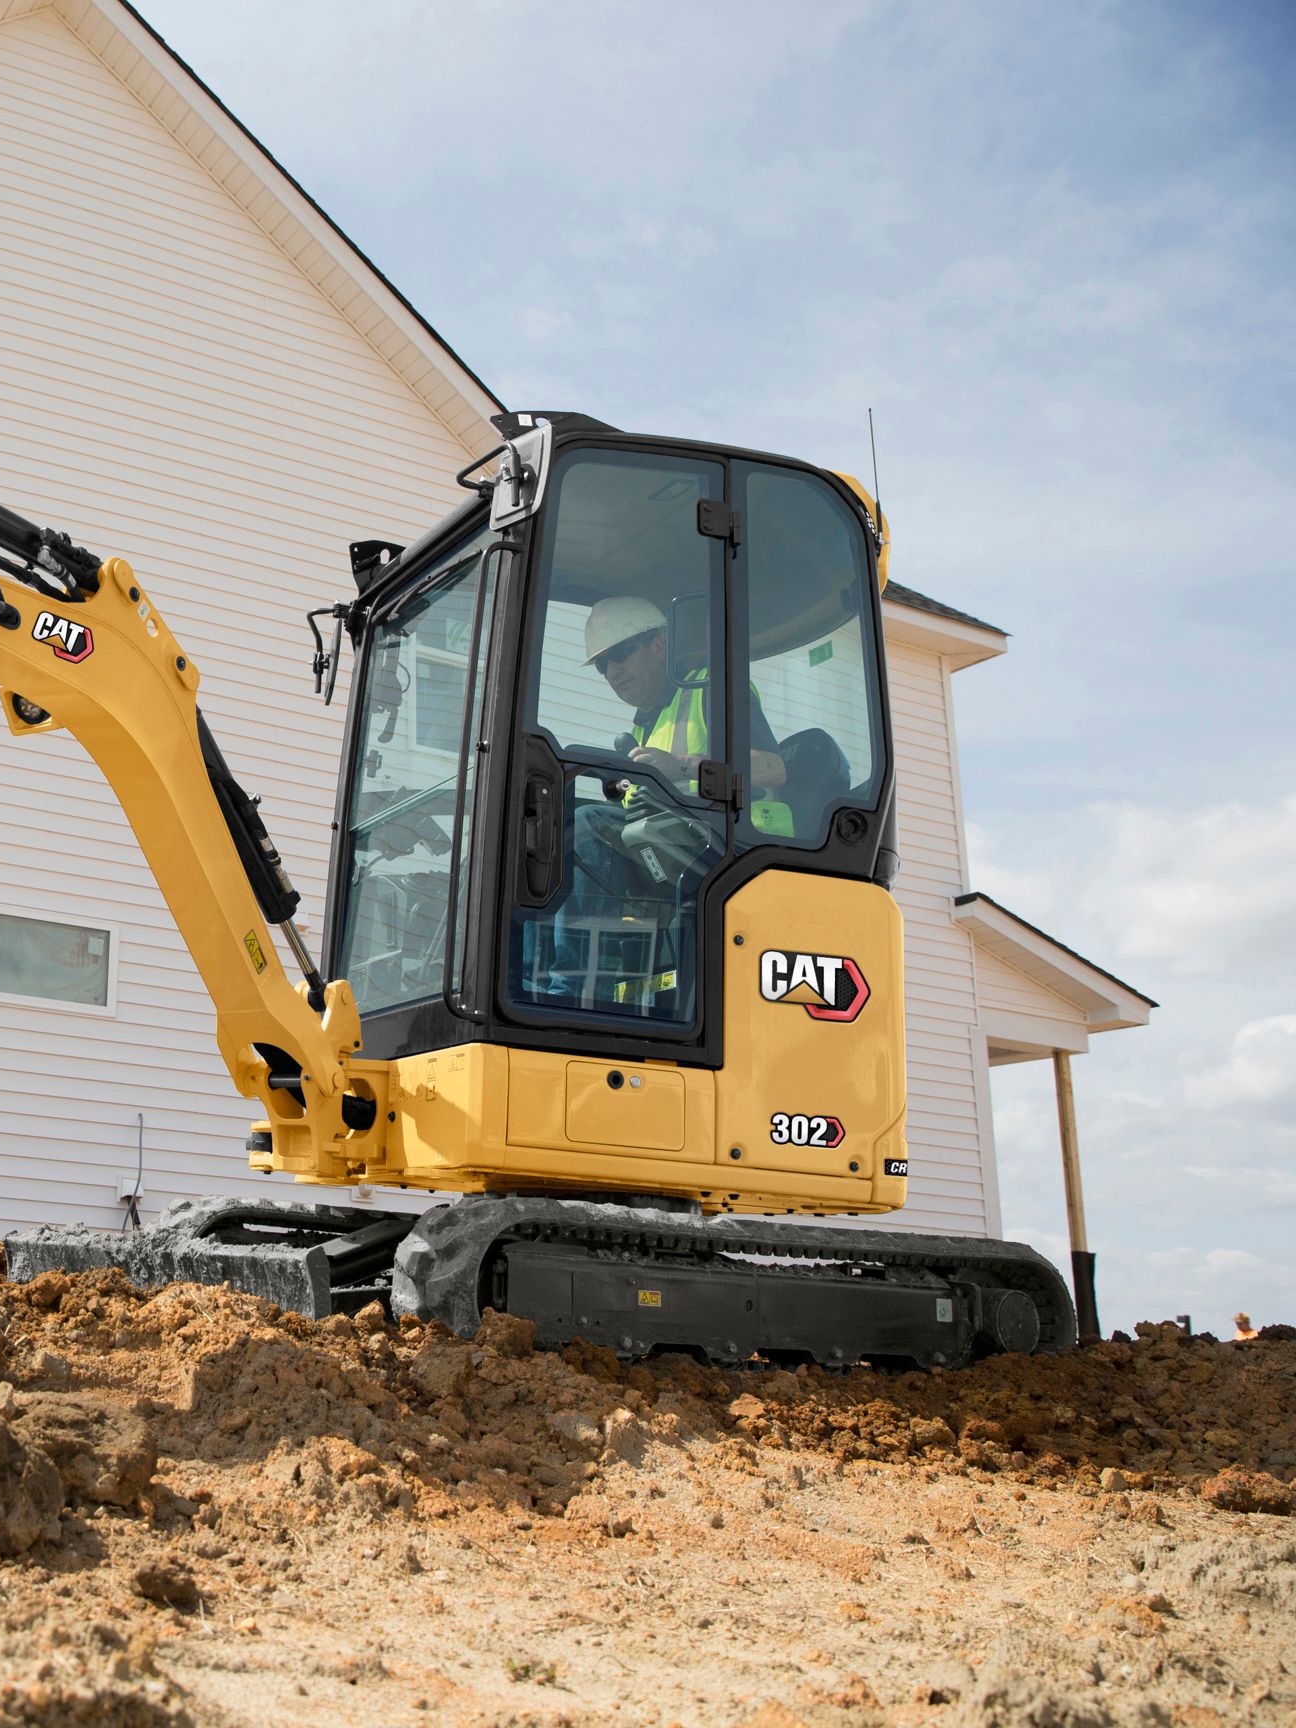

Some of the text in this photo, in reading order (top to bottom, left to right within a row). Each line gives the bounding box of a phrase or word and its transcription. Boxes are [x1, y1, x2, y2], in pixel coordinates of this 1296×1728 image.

[33, 612, 85, 653] CAT
[761, 951, 843, 1006] CAT
[772, 1114, 828, 1146] 302
[890, 1162, 908, 1174] CR
